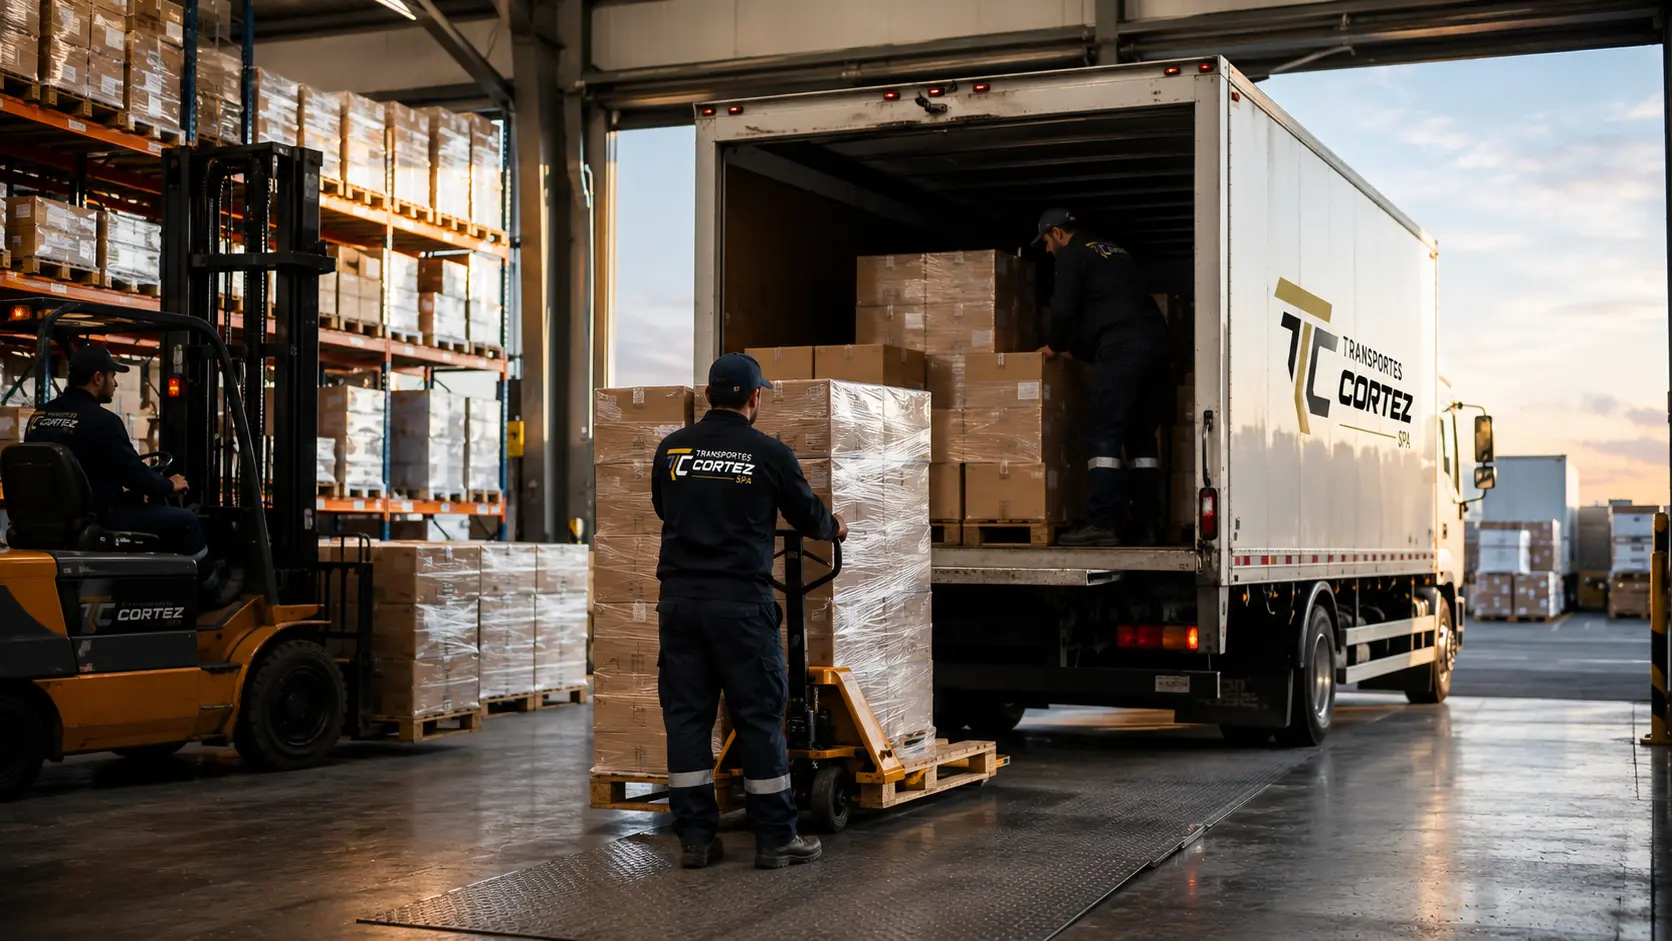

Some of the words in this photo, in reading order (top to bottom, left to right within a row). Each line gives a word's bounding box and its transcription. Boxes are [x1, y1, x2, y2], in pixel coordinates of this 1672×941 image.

[1343, 336, 1403, 380] TRANSPORTES
[1339, 369, 1413, 423] CORTEZ
[1398, 430, 1411, 449] SPA
[696, 449, 752, 461] TRANSPORTES
[692, 459, 755, 475] CORTEZ
[735, 475, 752, 485] SPA
[117, 606, 184, 621] CORTEZ
